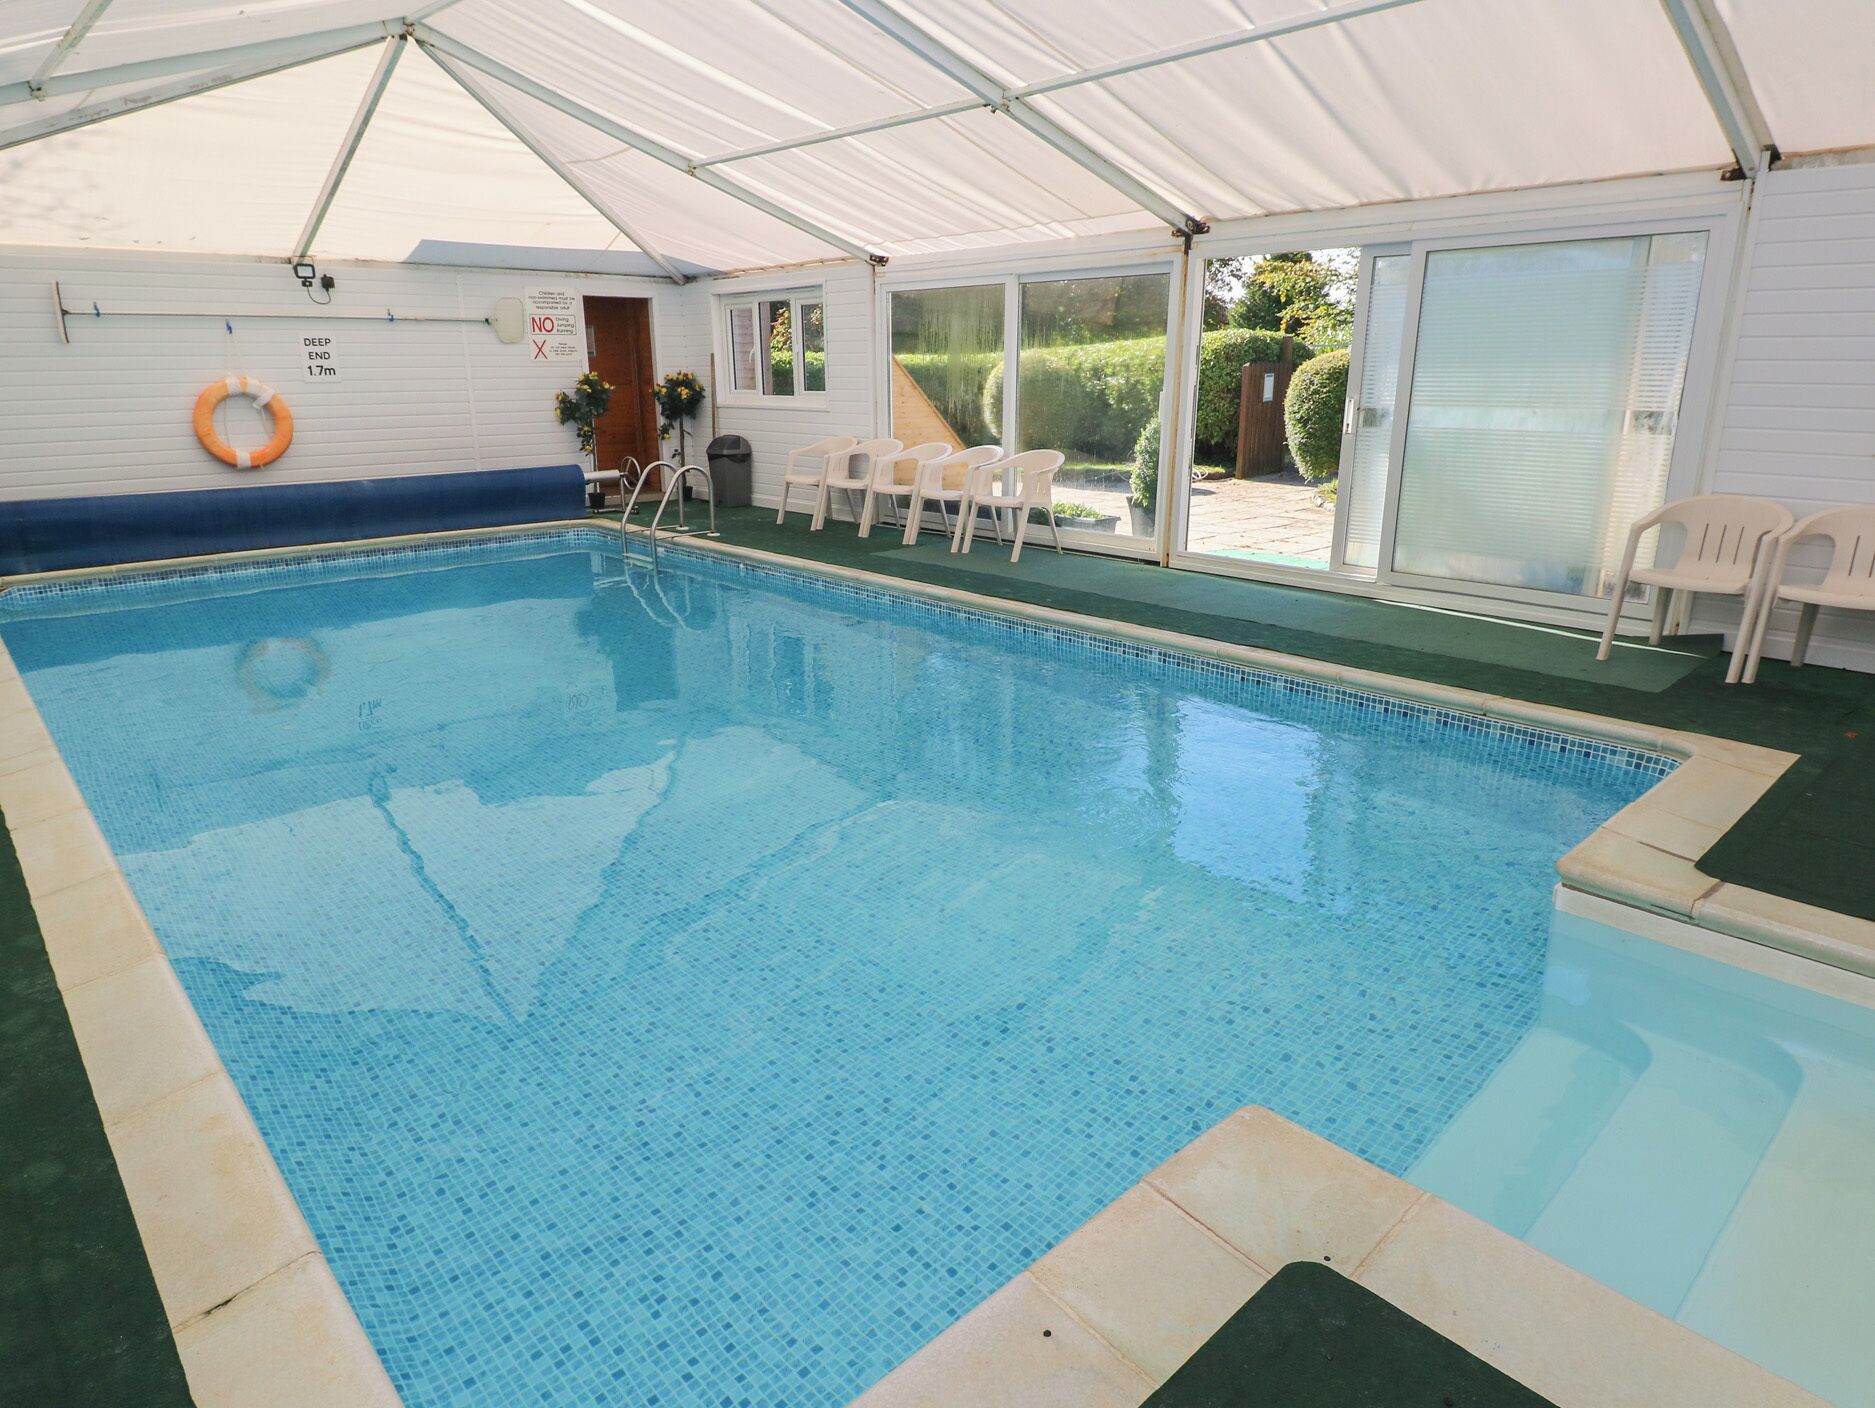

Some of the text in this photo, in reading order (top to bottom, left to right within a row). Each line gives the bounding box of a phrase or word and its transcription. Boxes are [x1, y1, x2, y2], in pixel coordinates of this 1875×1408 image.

[531, 316, 554, 333] NO
[303, 337, 331, 347] DEEP
[308, 351, 331, 360] END
[307, 365, 336, 376] 1.7m
